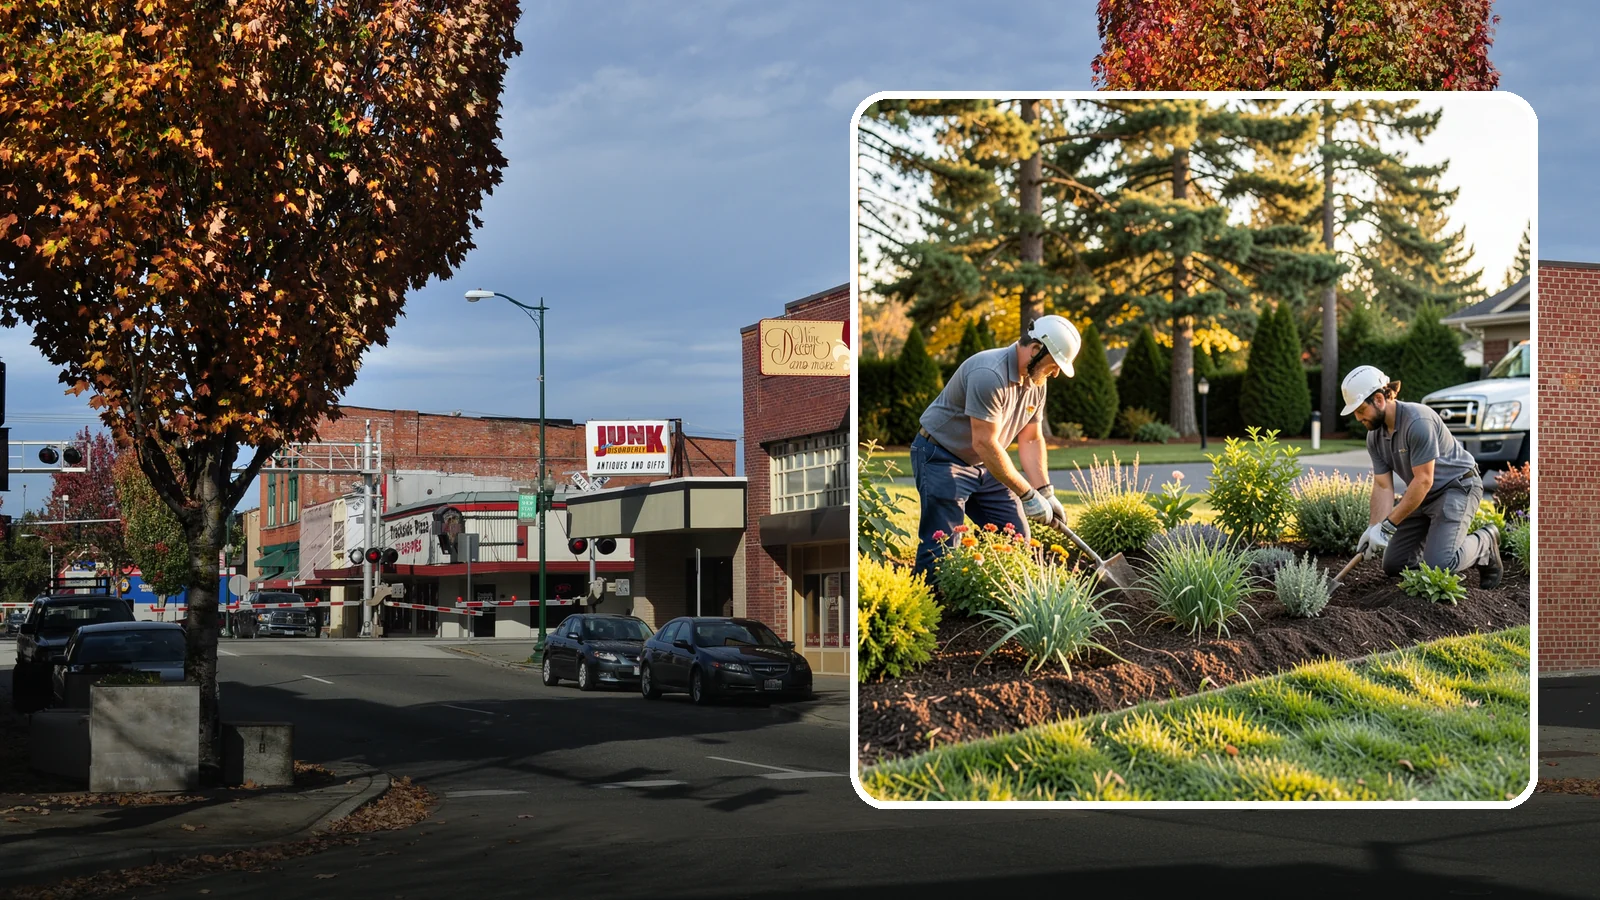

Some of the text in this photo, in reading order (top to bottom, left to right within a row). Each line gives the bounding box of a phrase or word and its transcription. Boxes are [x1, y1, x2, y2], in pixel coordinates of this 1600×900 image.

[765, 328, 831, 365] Decor
[596, 425, 665, 457] JUNK
[607, 446, 646, 454] DISORDERLY
[597, 460, 665, 470] ANTIQUES AND GIFTS
